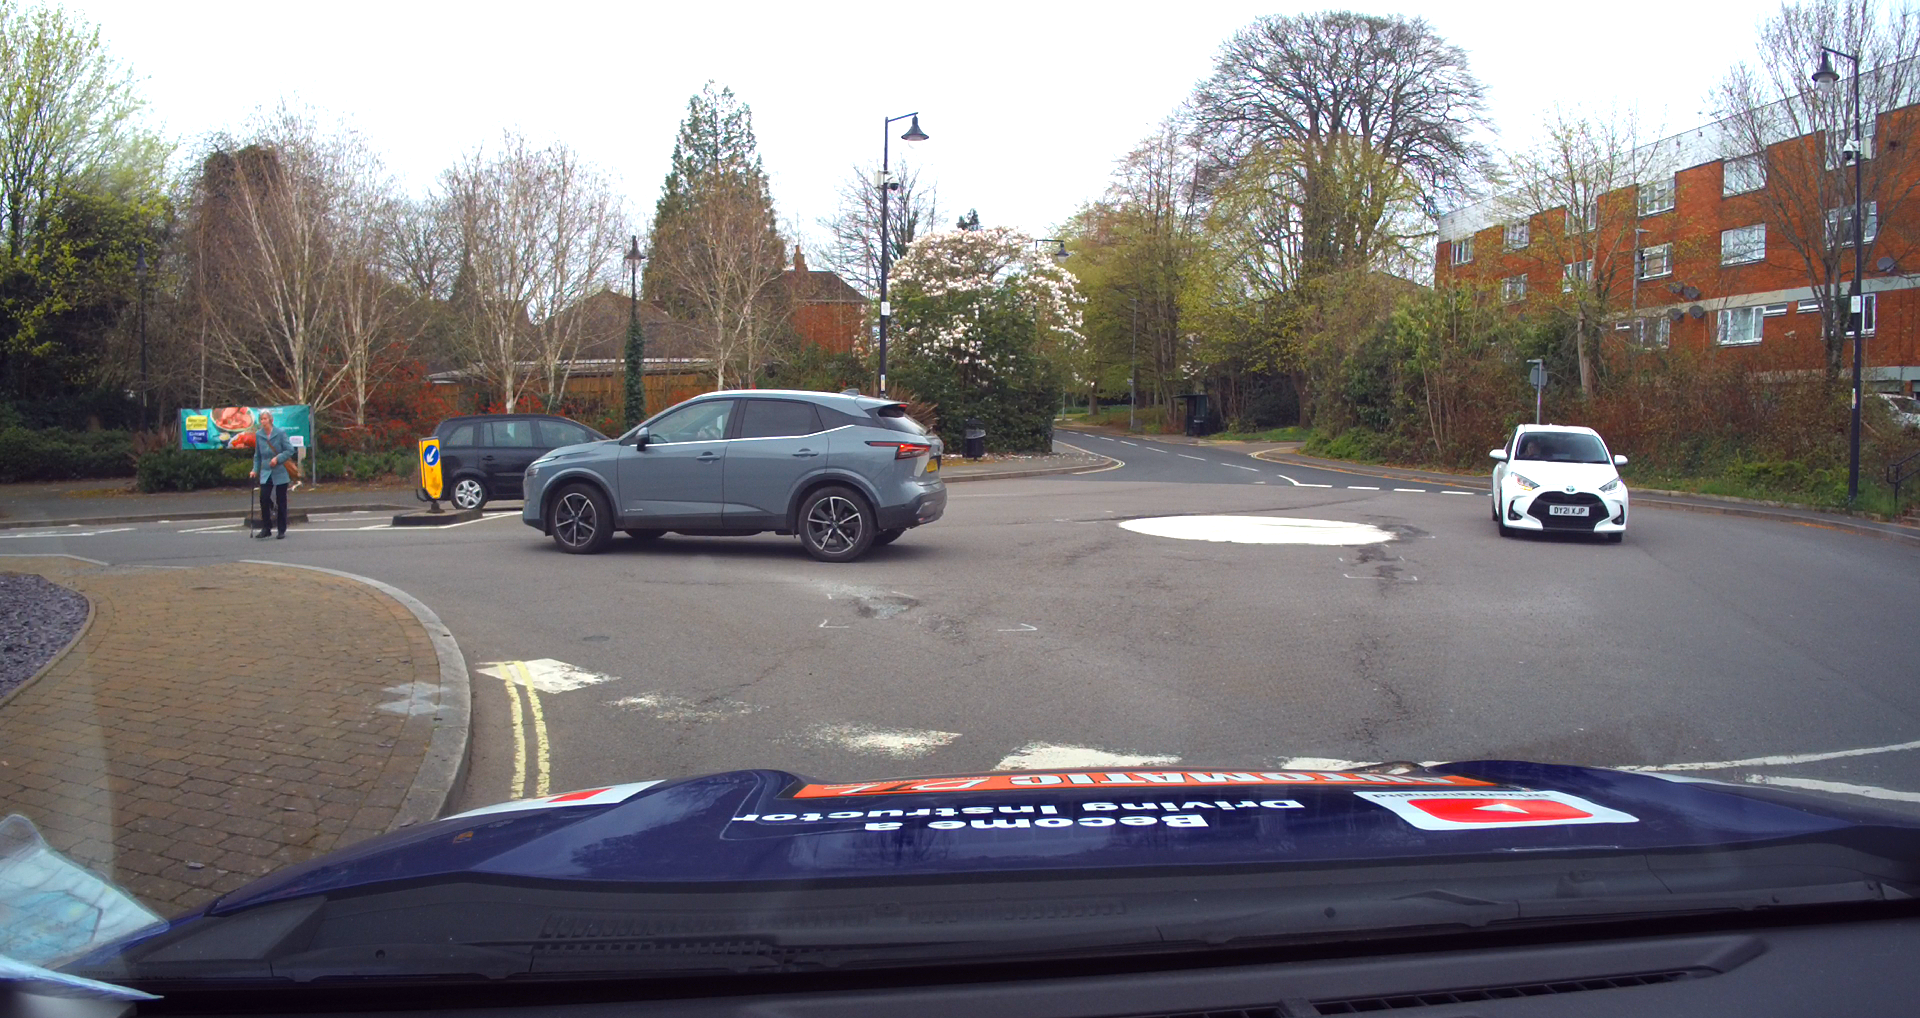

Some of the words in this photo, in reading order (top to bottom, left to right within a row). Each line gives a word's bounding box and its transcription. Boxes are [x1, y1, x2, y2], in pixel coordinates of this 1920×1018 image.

[1554, 506, 1570, 515] DY21
[1571, 507, 1586, 515] XJP
[1009, 772, 1455, 786] AUTOMATIC
[1082, 800, 1305, 812] Driving
[731, 805, 1058, 822] Instructor
[864, 821, 904, 832] a
[927, 814, 1209, 830] Become
